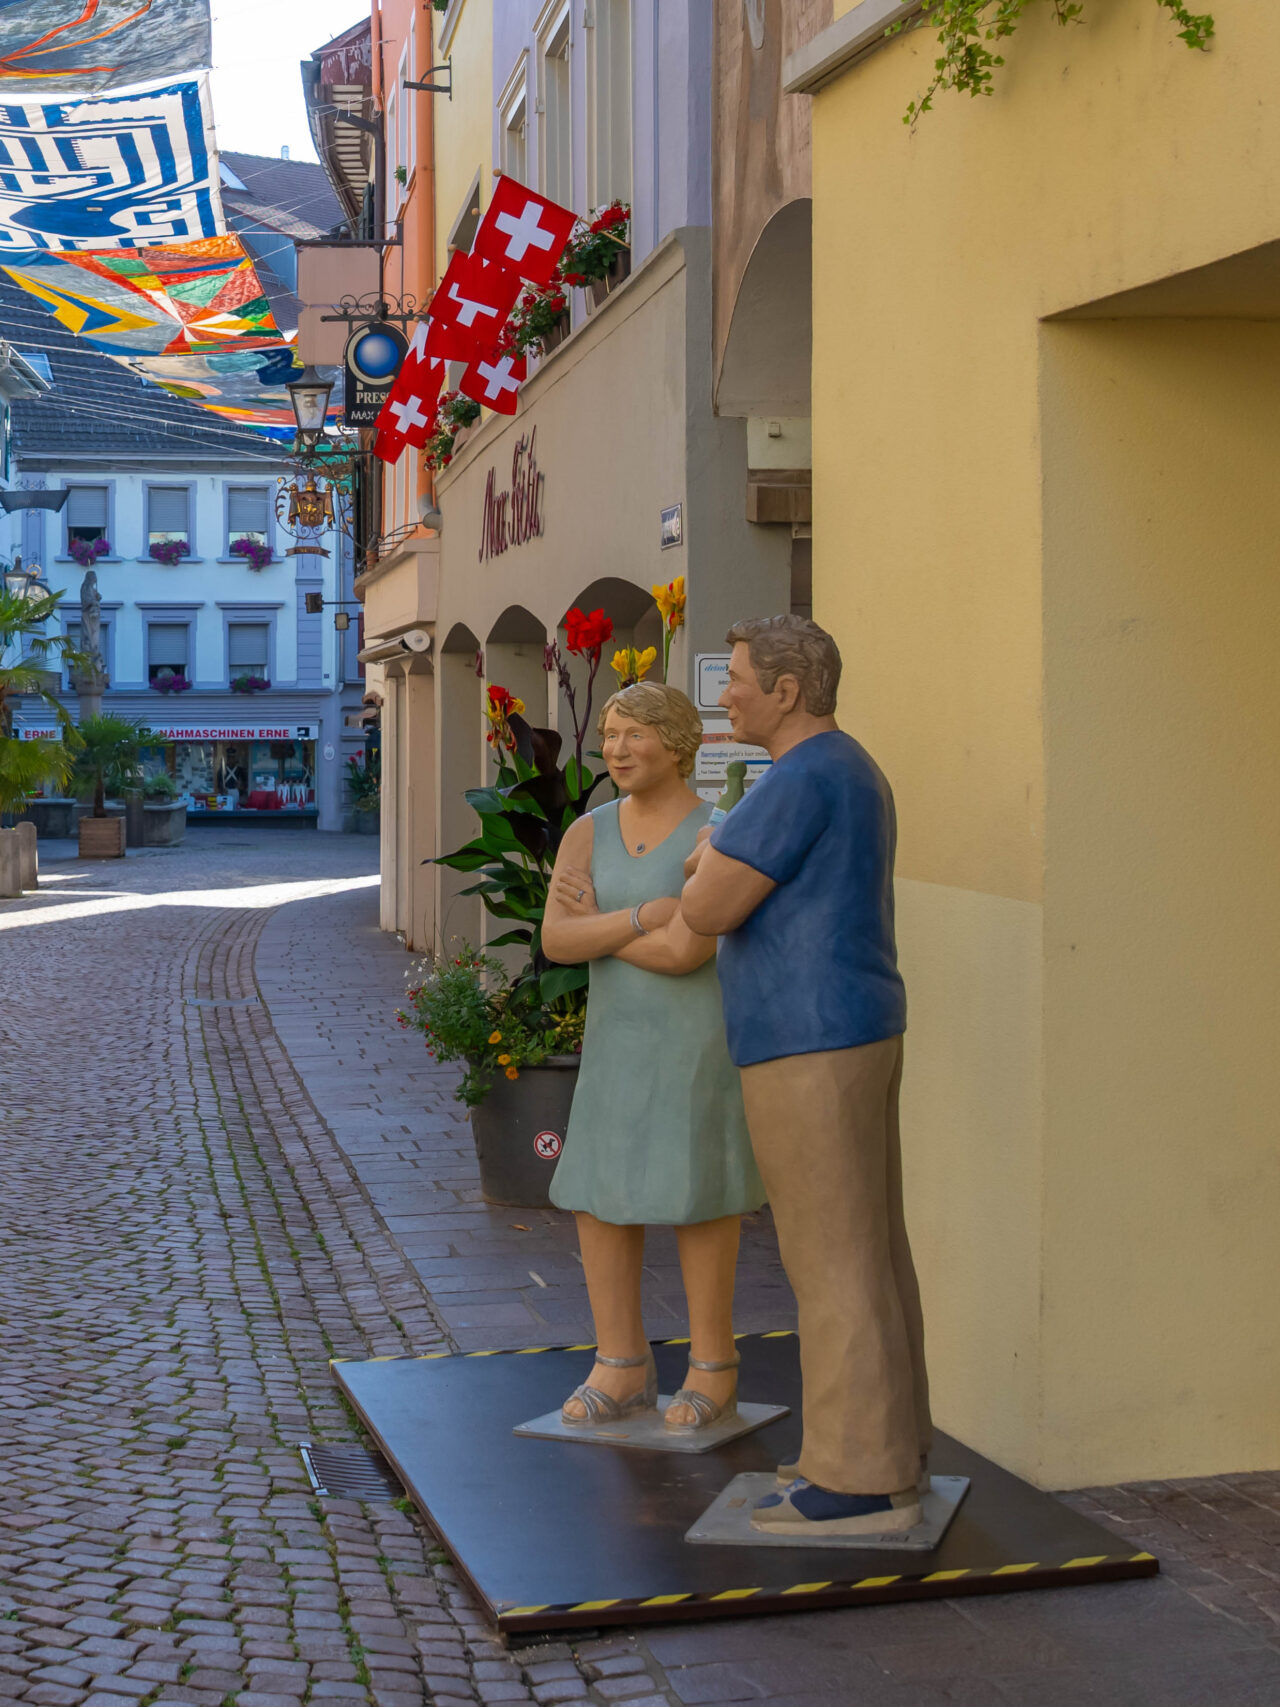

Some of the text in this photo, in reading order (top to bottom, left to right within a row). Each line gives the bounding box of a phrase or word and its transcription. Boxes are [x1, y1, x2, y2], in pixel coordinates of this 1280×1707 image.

[351, 410, 375, 420] MAX
[24, 730, 56, 739] ERNE
[159, 727, 289, 738] NÄHMASCHINEN ERNE
